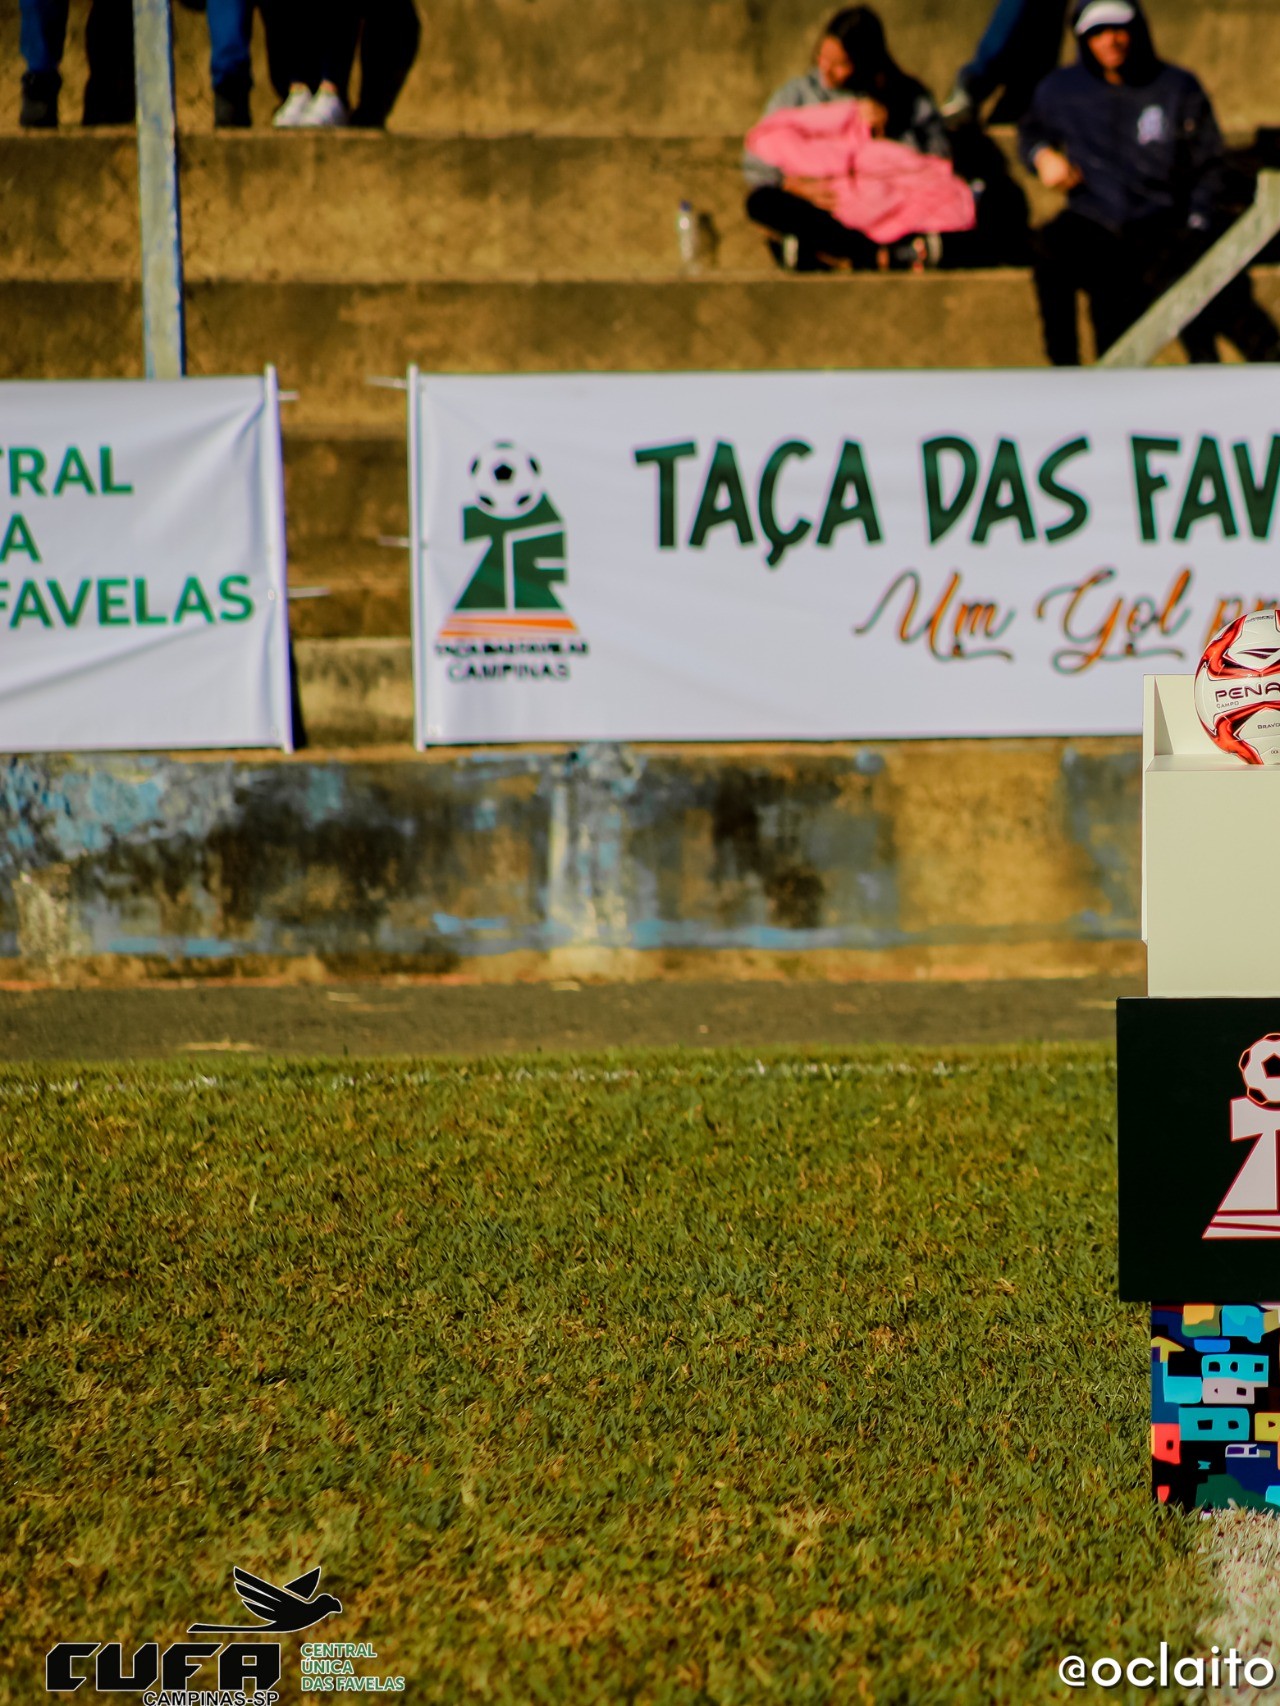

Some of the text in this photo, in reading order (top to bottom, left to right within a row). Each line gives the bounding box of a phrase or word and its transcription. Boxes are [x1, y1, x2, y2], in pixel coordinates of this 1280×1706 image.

[633, 440, 883, 569] TAÇA
[921, 435, 1091, 546] DAS
[853, 569, 1016, 662] Um
[1034, 565, 1192, 675] Gol
[1216, 701, 1239, 709] CAMPO
